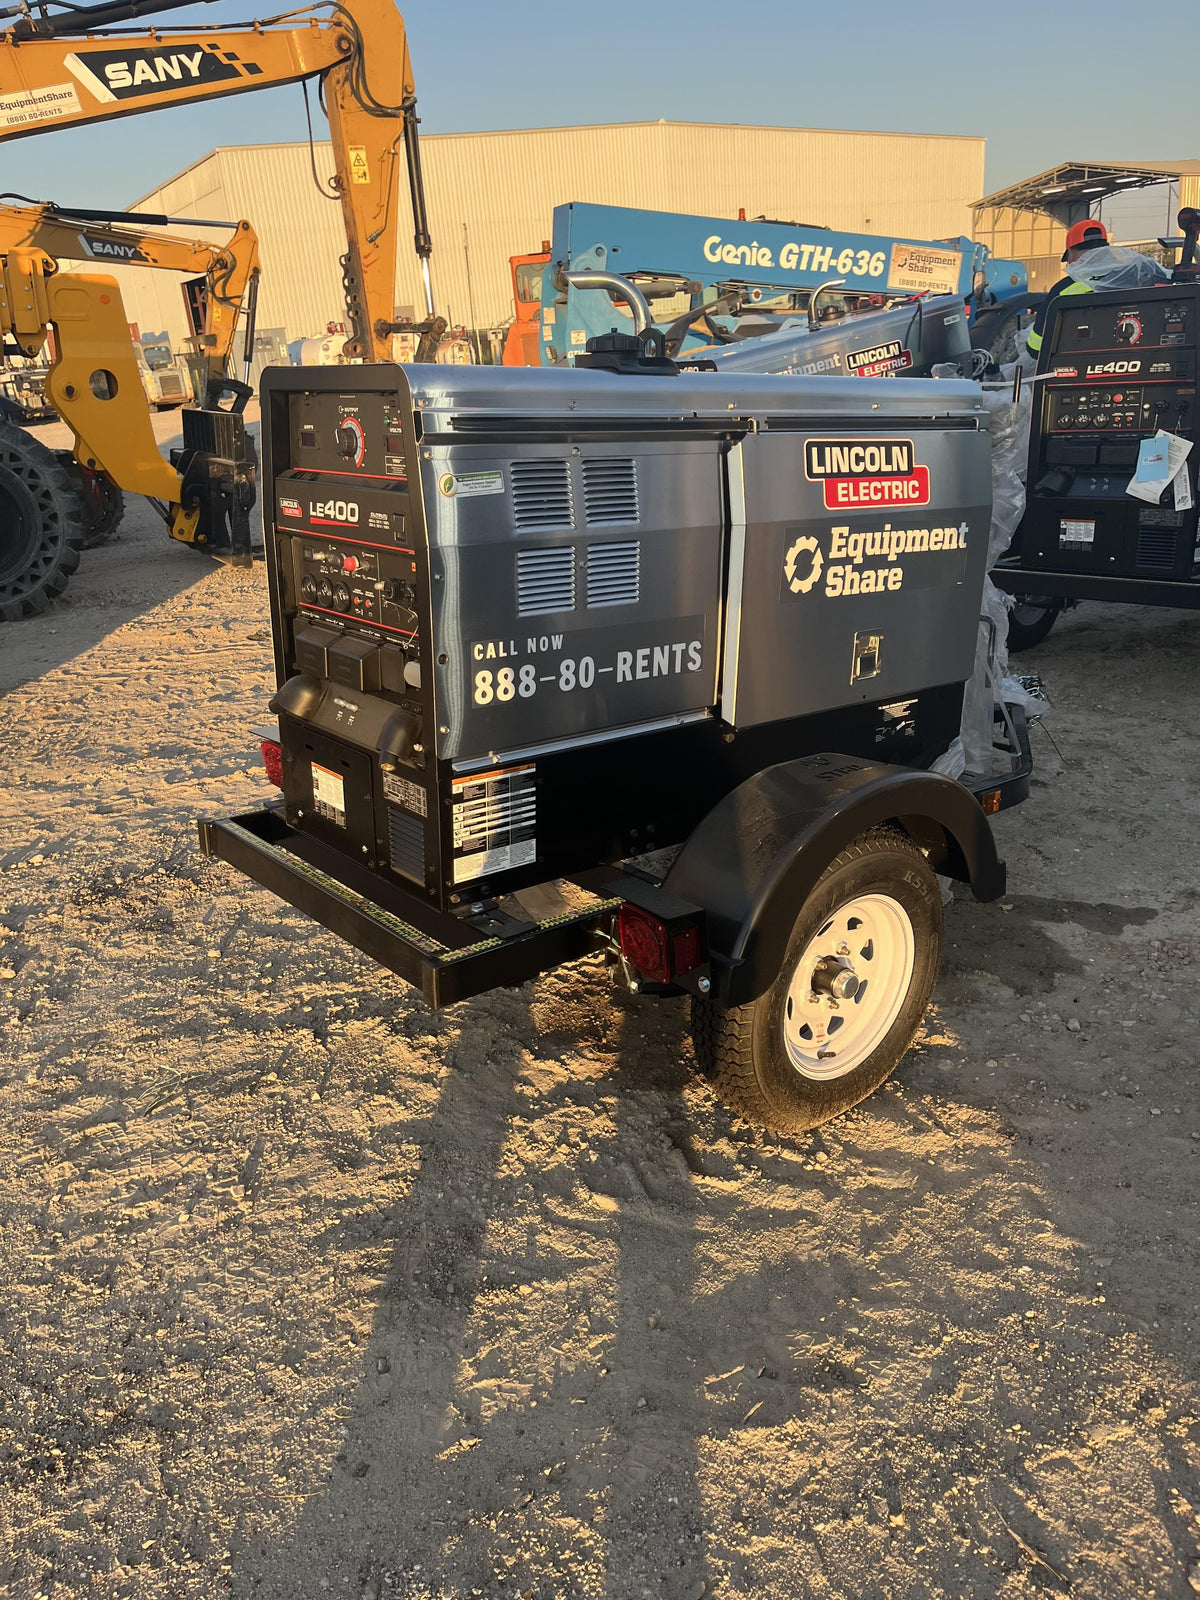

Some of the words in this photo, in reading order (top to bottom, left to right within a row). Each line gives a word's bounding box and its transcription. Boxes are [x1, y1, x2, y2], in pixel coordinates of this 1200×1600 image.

[104, 51, 204, 89] SANY
[0, 91, 73, 110] EquipmentShare
[92, 241, 136, 259] SANY
[703, 235, 772, 268] Genie
[778, 243, 887, 277] GTH-636
[909, 251, 957, 266] Equipment
[908, 263, 933, 274] Share
[849, 343, 900, 369] LINCOLN
[863, 357, 908, 377] ELECTRIC
[1086, 360, 1141, 374] LE400
[811, 445, 909, 474] LINCOLN
[837, 480, 920, 502] ELECTRIC
[309, 500, 359, 522] LE400
[829, 521, 969, 564] Equipment
[825, 565, 903, 598] Share
[473, 640, 518, 661] CALL
[527, 634, 564, 653] NOW
[474, 640, 702, 706] 888-80-RENTS
